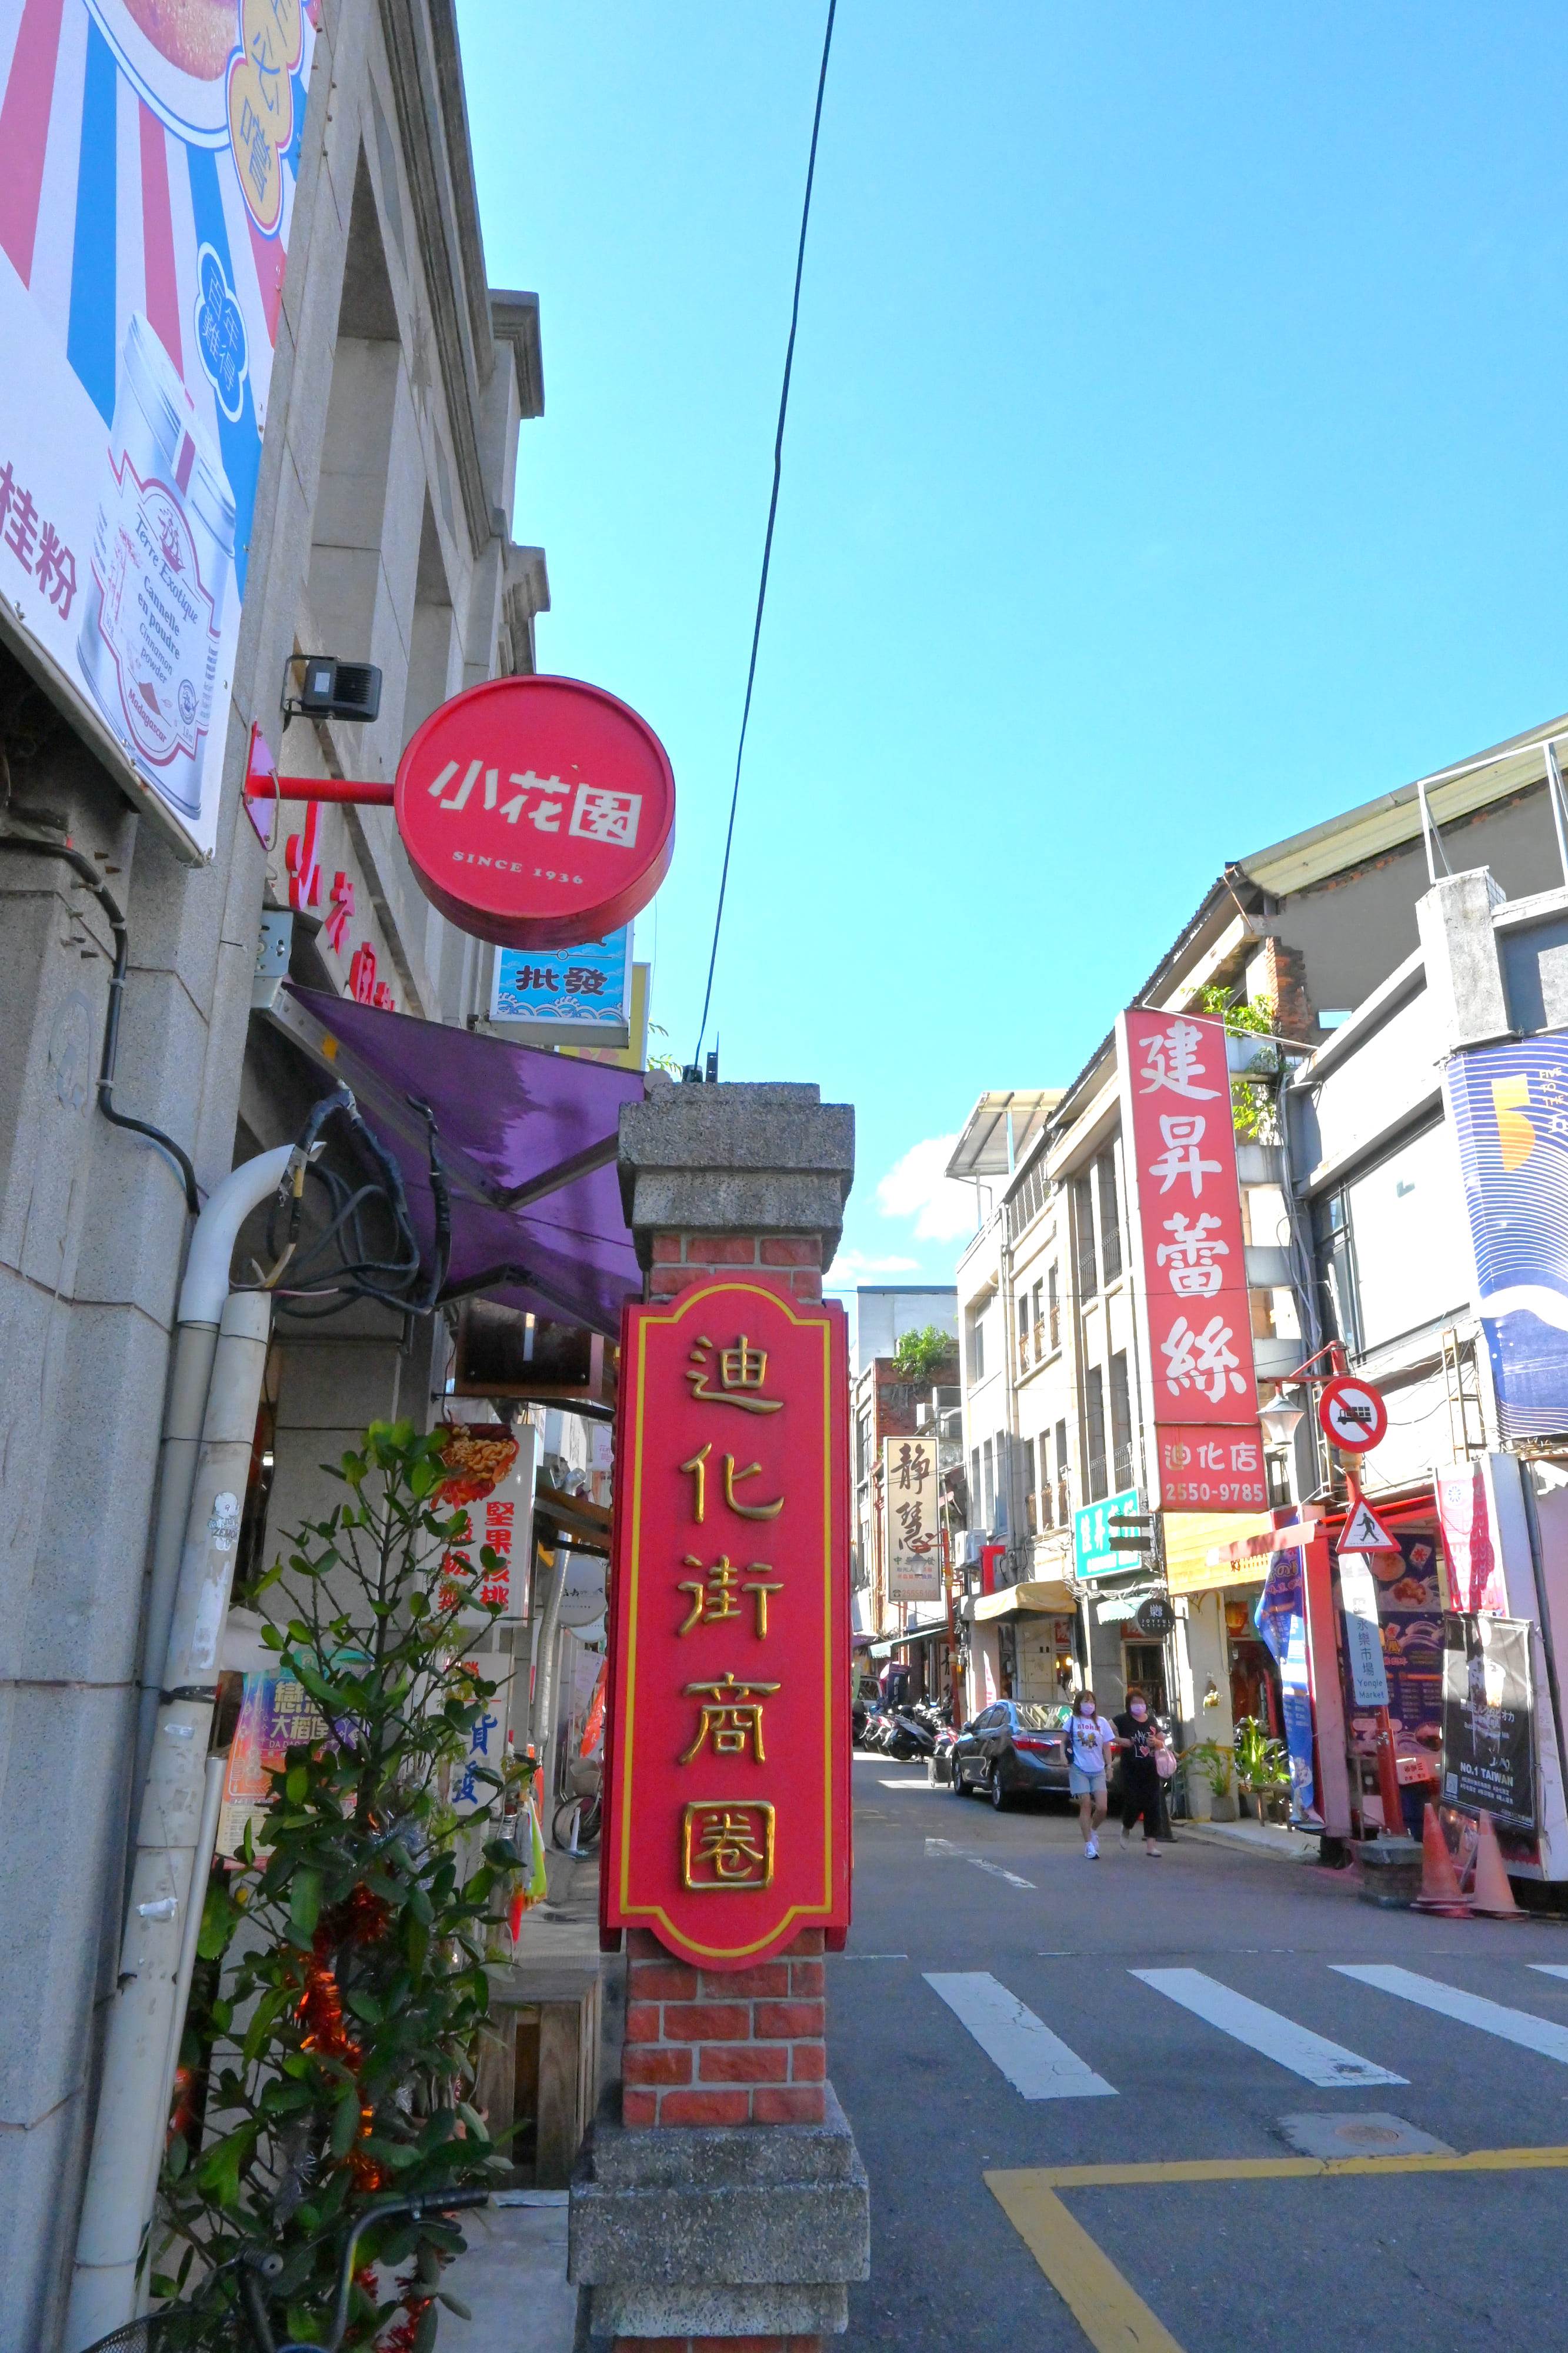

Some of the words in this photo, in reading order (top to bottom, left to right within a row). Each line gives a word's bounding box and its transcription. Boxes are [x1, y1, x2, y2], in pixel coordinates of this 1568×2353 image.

[135, 512, 159, 566] Terre
[158, 558, 199, 625] Exotique
[144, 575, 179, 637] Cannelle
[138, 592, 148, 615] en
[149, 612, 180, 660] poudre
[139, 622, 172, 676] Cinnamon
[141, 646, 167, 691] powder
[128, 687, 167, 743] Madagascar
[426, 759, 643, 849] 小花園
[452, 851, 522, 874] SINCE
[532, 868, 584, 885] 1936
[515, 965, 608, 996] 批發
[1539, 1066, 1563, 1079] FIVE
[1540, 1082, 1556, 1094] TO
[1542, 1094, 1564, 1107] THE
[1138, 1019, 1247, 1404] 建昇蕾絲
[1164, 1441, 1257, 1472] 迪化店
[1165, 1482, 1264, 1502] 2550-9785
[678, 1333, 785, 1890] 迪化街商圈
[1357, 1619, 1375, 1677] 永樂市場
[1357, 1679, 1383, 1690] Yongle
[1359, 1690, 1384, 1699] Market
[1460, 1761, 1479, 1777] NO.1
[1480, 1767, 1514, 1787] TAIWAN
